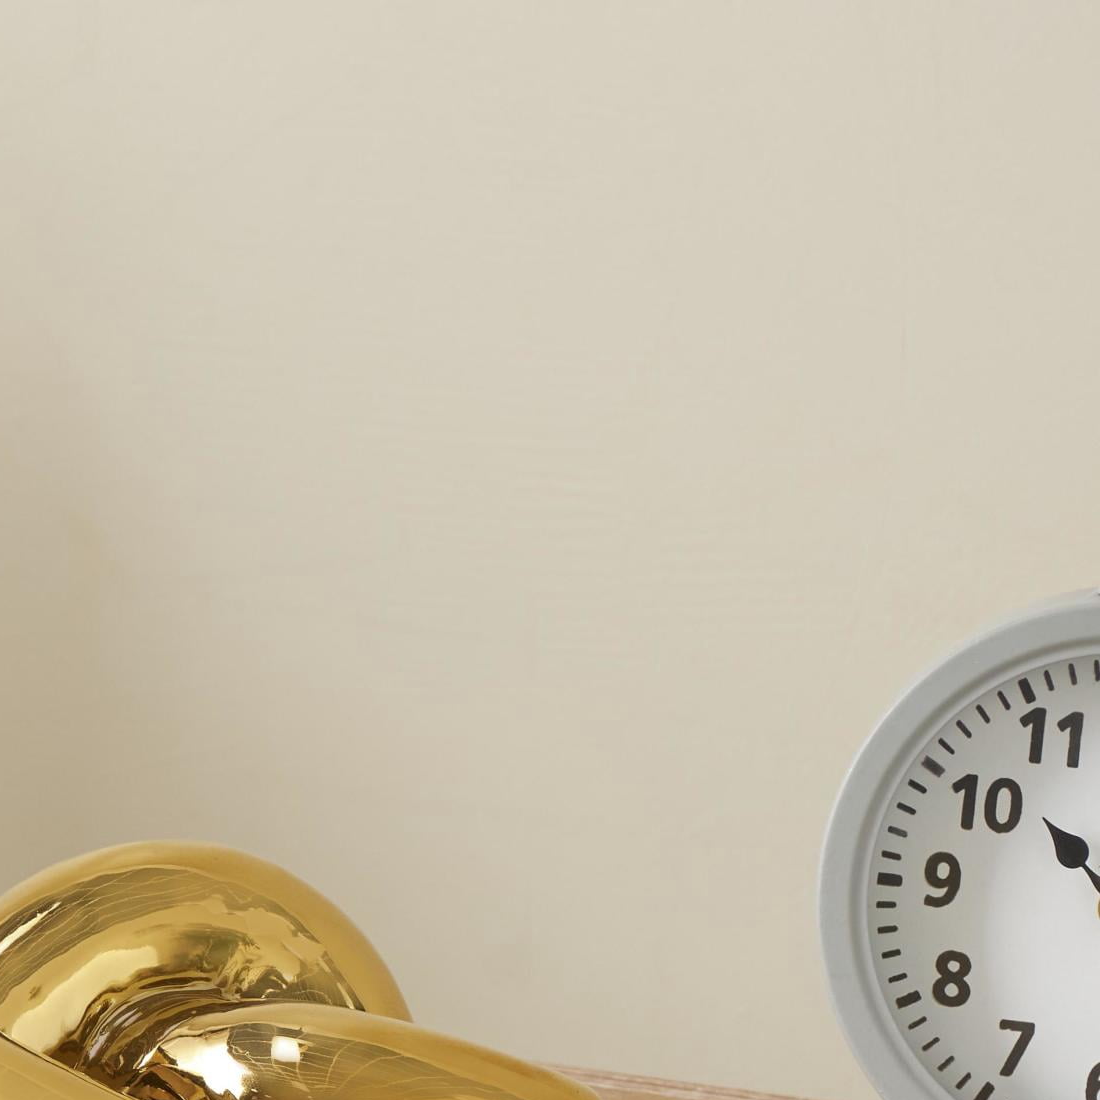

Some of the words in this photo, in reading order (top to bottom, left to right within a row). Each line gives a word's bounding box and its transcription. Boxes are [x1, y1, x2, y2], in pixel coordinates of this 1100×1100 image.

[1020, 707, 1084, 769] 11
[952, 774, 1023, 834] 10
[924, 852, 962, 908] 9
[932, 950, 972, 1007] 8
[999, 1019, 1036, 1077] 7
